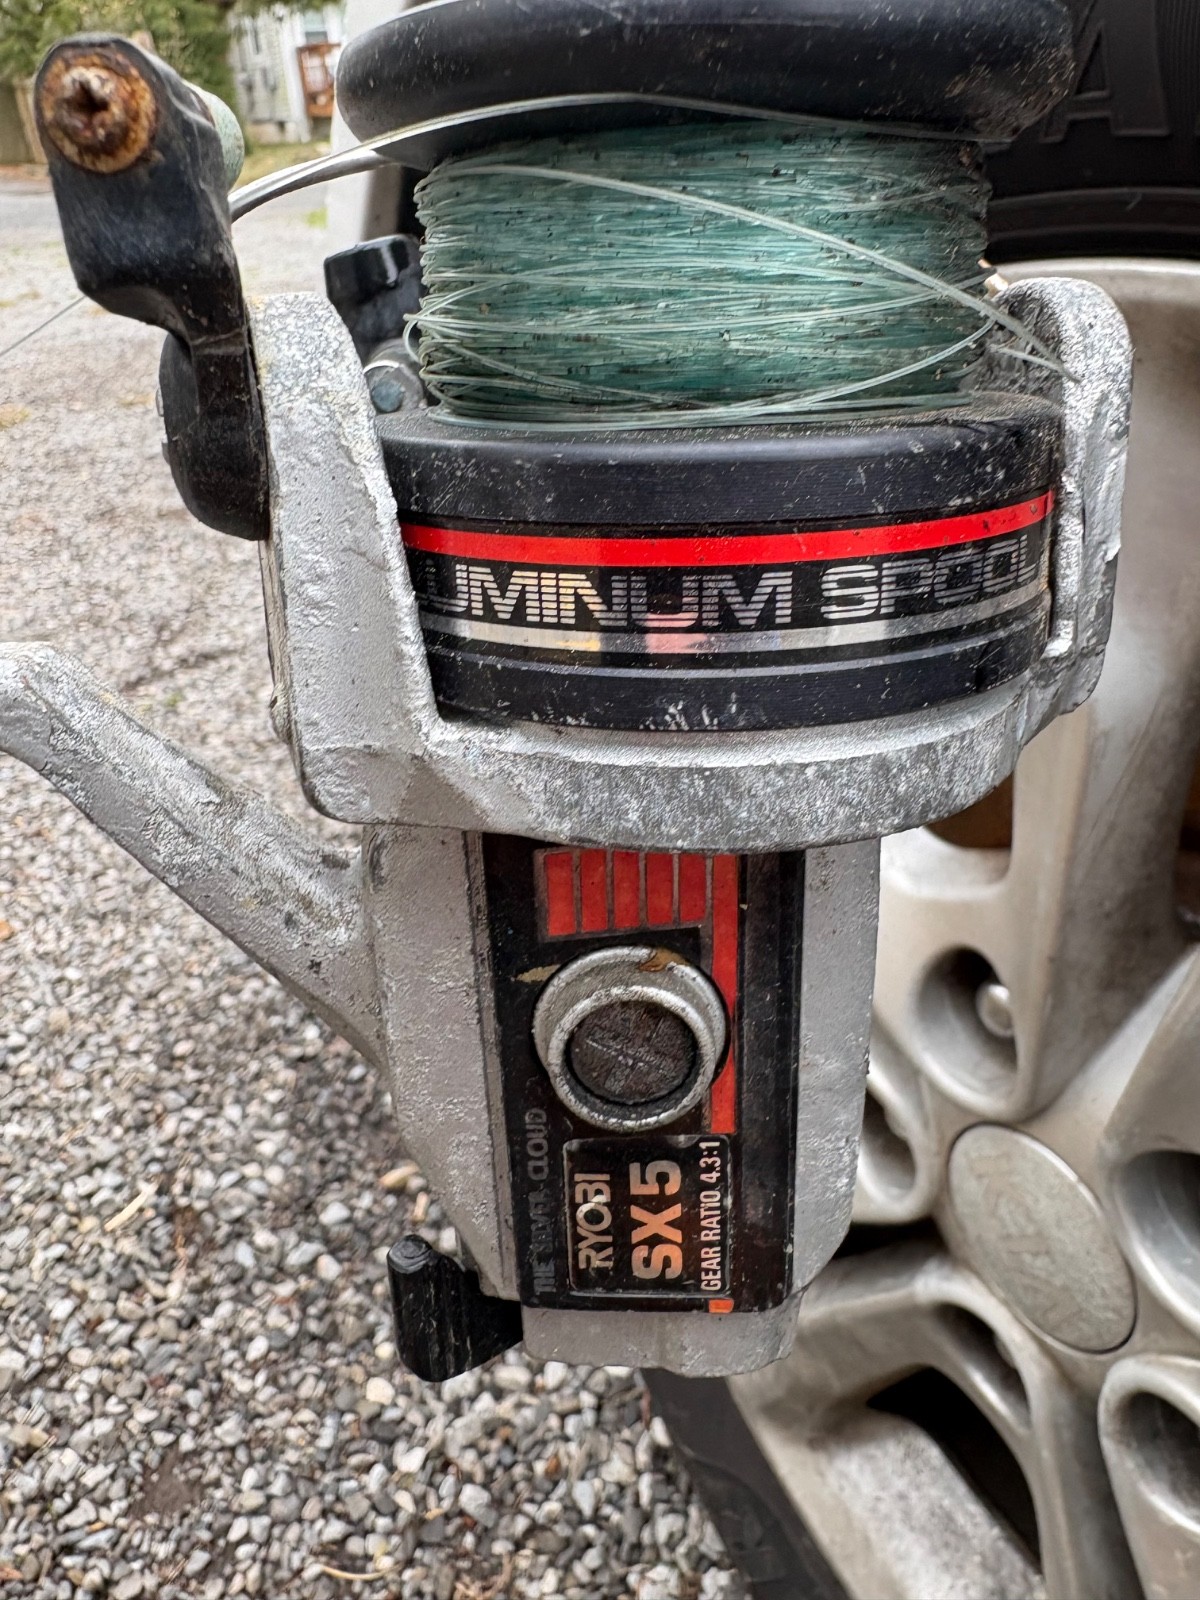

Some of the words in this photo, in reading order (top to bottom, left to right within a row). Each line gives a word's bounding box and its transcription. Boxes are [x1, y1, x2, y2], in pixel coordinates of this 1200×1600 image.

[416, 559, 792, 628] UMINUM
[821, 534, 1037, 619] SPOOL
[525, 1108, 549, 1181] CLOUD
[699, 1141, 721, 1184] 4.3:1
[574, 1173, 614, 1271] RYOBI
[700, 1190, 721, 1241] RATIO
[701, 1246, 721, 1291] GEAR
